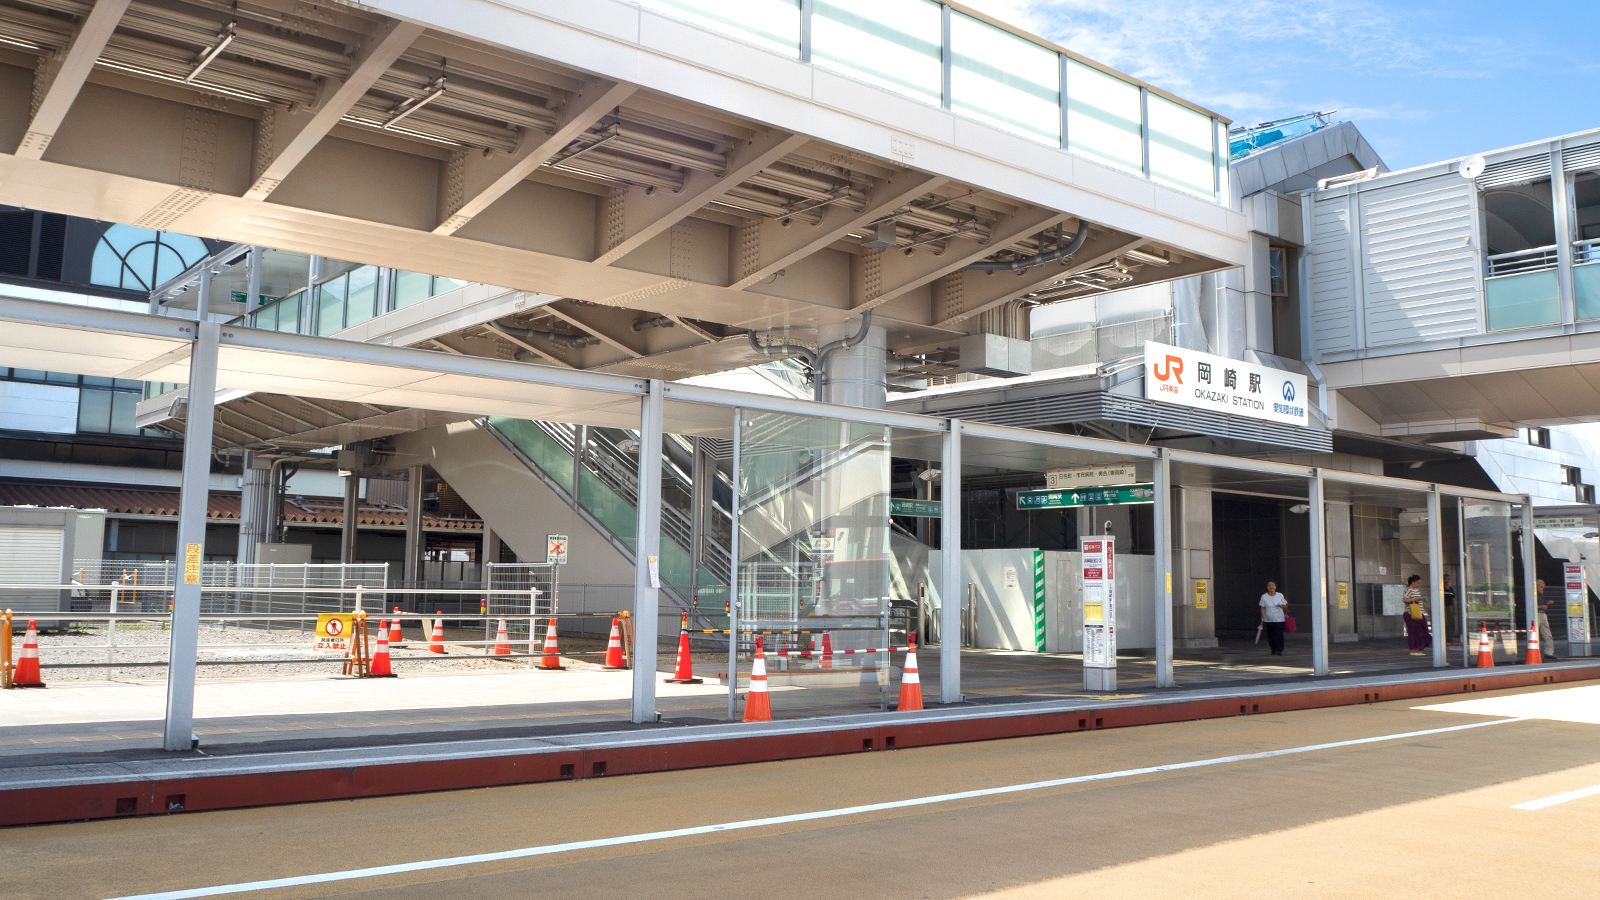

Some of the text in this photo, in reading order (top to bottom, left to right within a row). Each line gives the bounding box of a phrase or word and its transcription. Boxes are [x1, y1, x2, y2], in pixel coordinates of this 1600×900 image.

[1153, 354, 1184, 385] JR
[1197, 361, 1262, 394] 岡崎駅
[1159, 383, 1179, 395] JR東海
[1194, 388, 1265, 411] OKAZAKI STATION
[1273, 402, 1304, 418] 愛知環状鉄道
[184, 543, 201, 584] 段差注意
